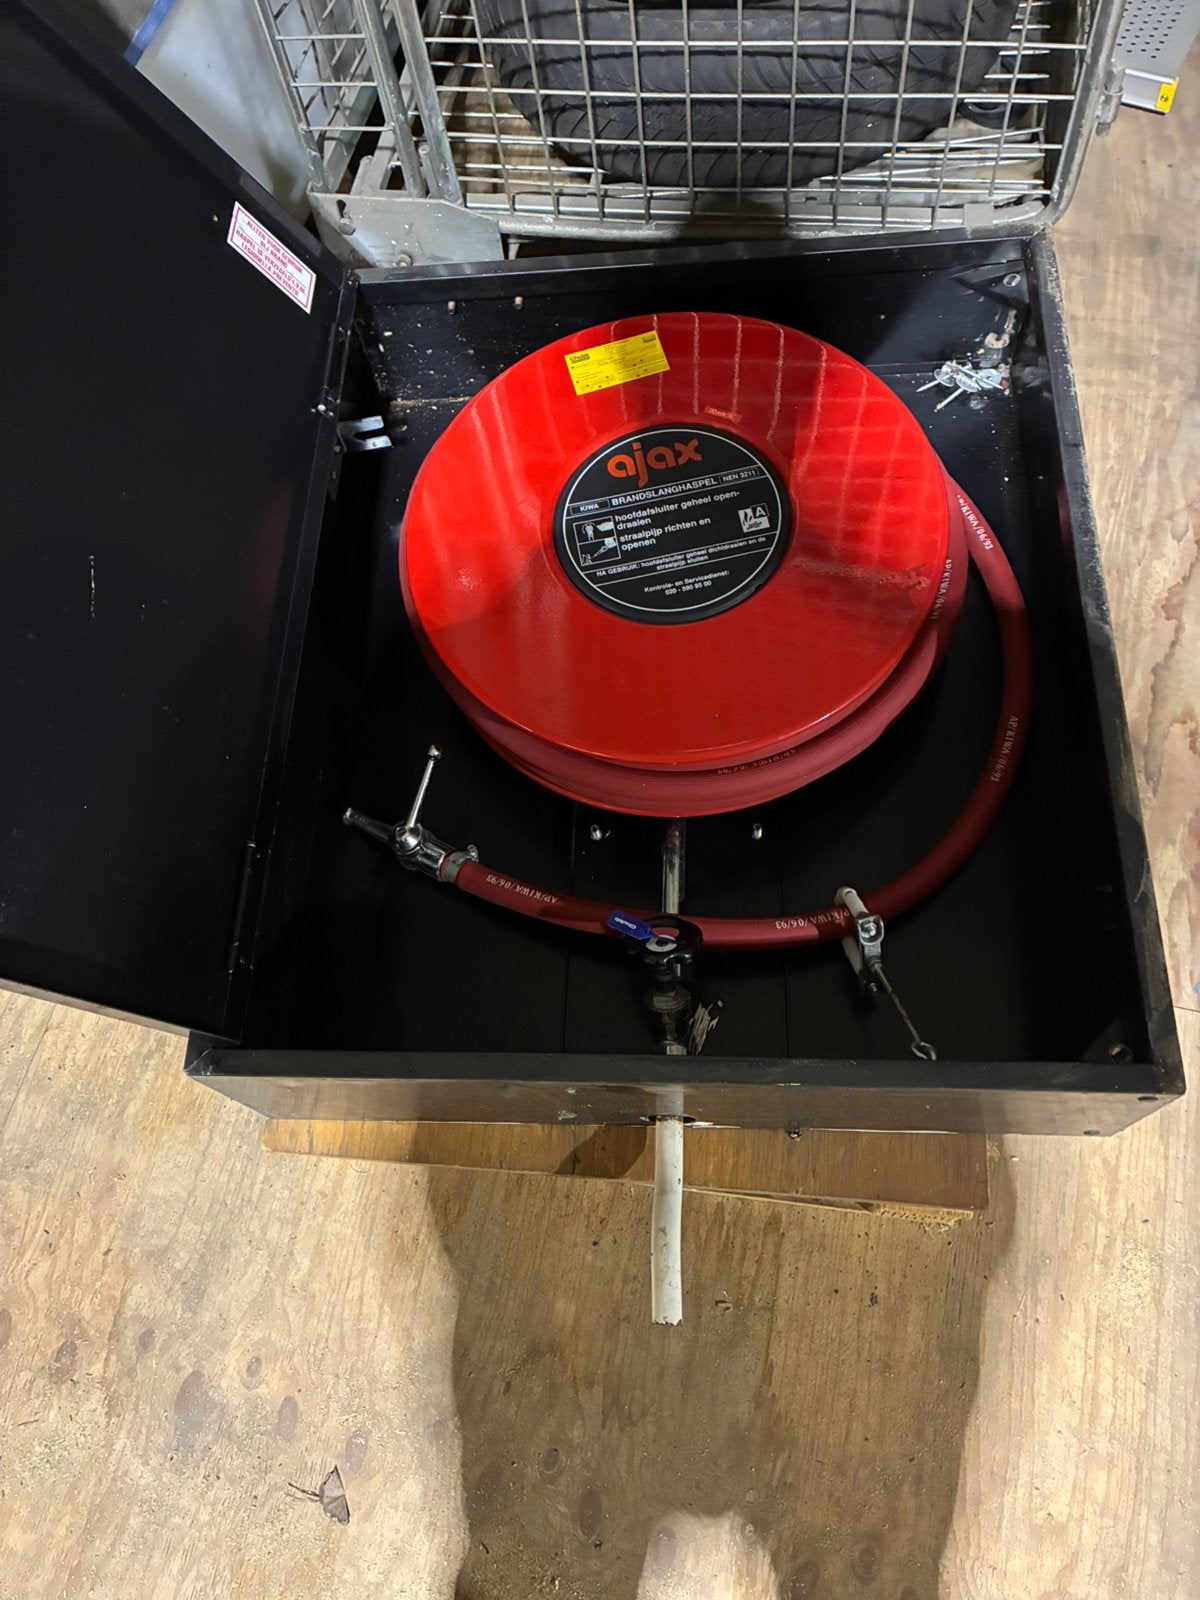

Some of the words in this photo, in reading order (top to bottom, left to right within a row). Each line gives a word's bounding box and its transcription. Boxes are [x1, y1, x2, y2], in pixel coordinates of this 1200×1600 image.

[606, 438, 703, 488] ajax
[580, 503, 600, 512] KIWA
[611, 477, 718, 506] BRANDSLANGHASPEL
[722, 473, 739, 482] NEN
[739, 470, 756, 478] 3211
[615, 502, 679, 522] hoofdafsluiter
[681, 495, 712, 510] geheel
[713, 491, 740, 501] open-
[755, 506, 767, 517] A
[617, 517, 652, 530] draaien
[619, 527, 663, 543] straalpijp
[664, 520, 698, 536] richten
[699, 517, 711, 525] en
[621, 538, 657, 551] openen
[608, 563, 640, 575] GEBRUIK:
[641, 554, 685, 568] hoofdafsluiter
[685, 549, 707, 559] geheel
[656, 560, 686, 571] straalpijp
[687, 555, 709, 564] sluiten
[614, 917, 637, 930] Chubb
